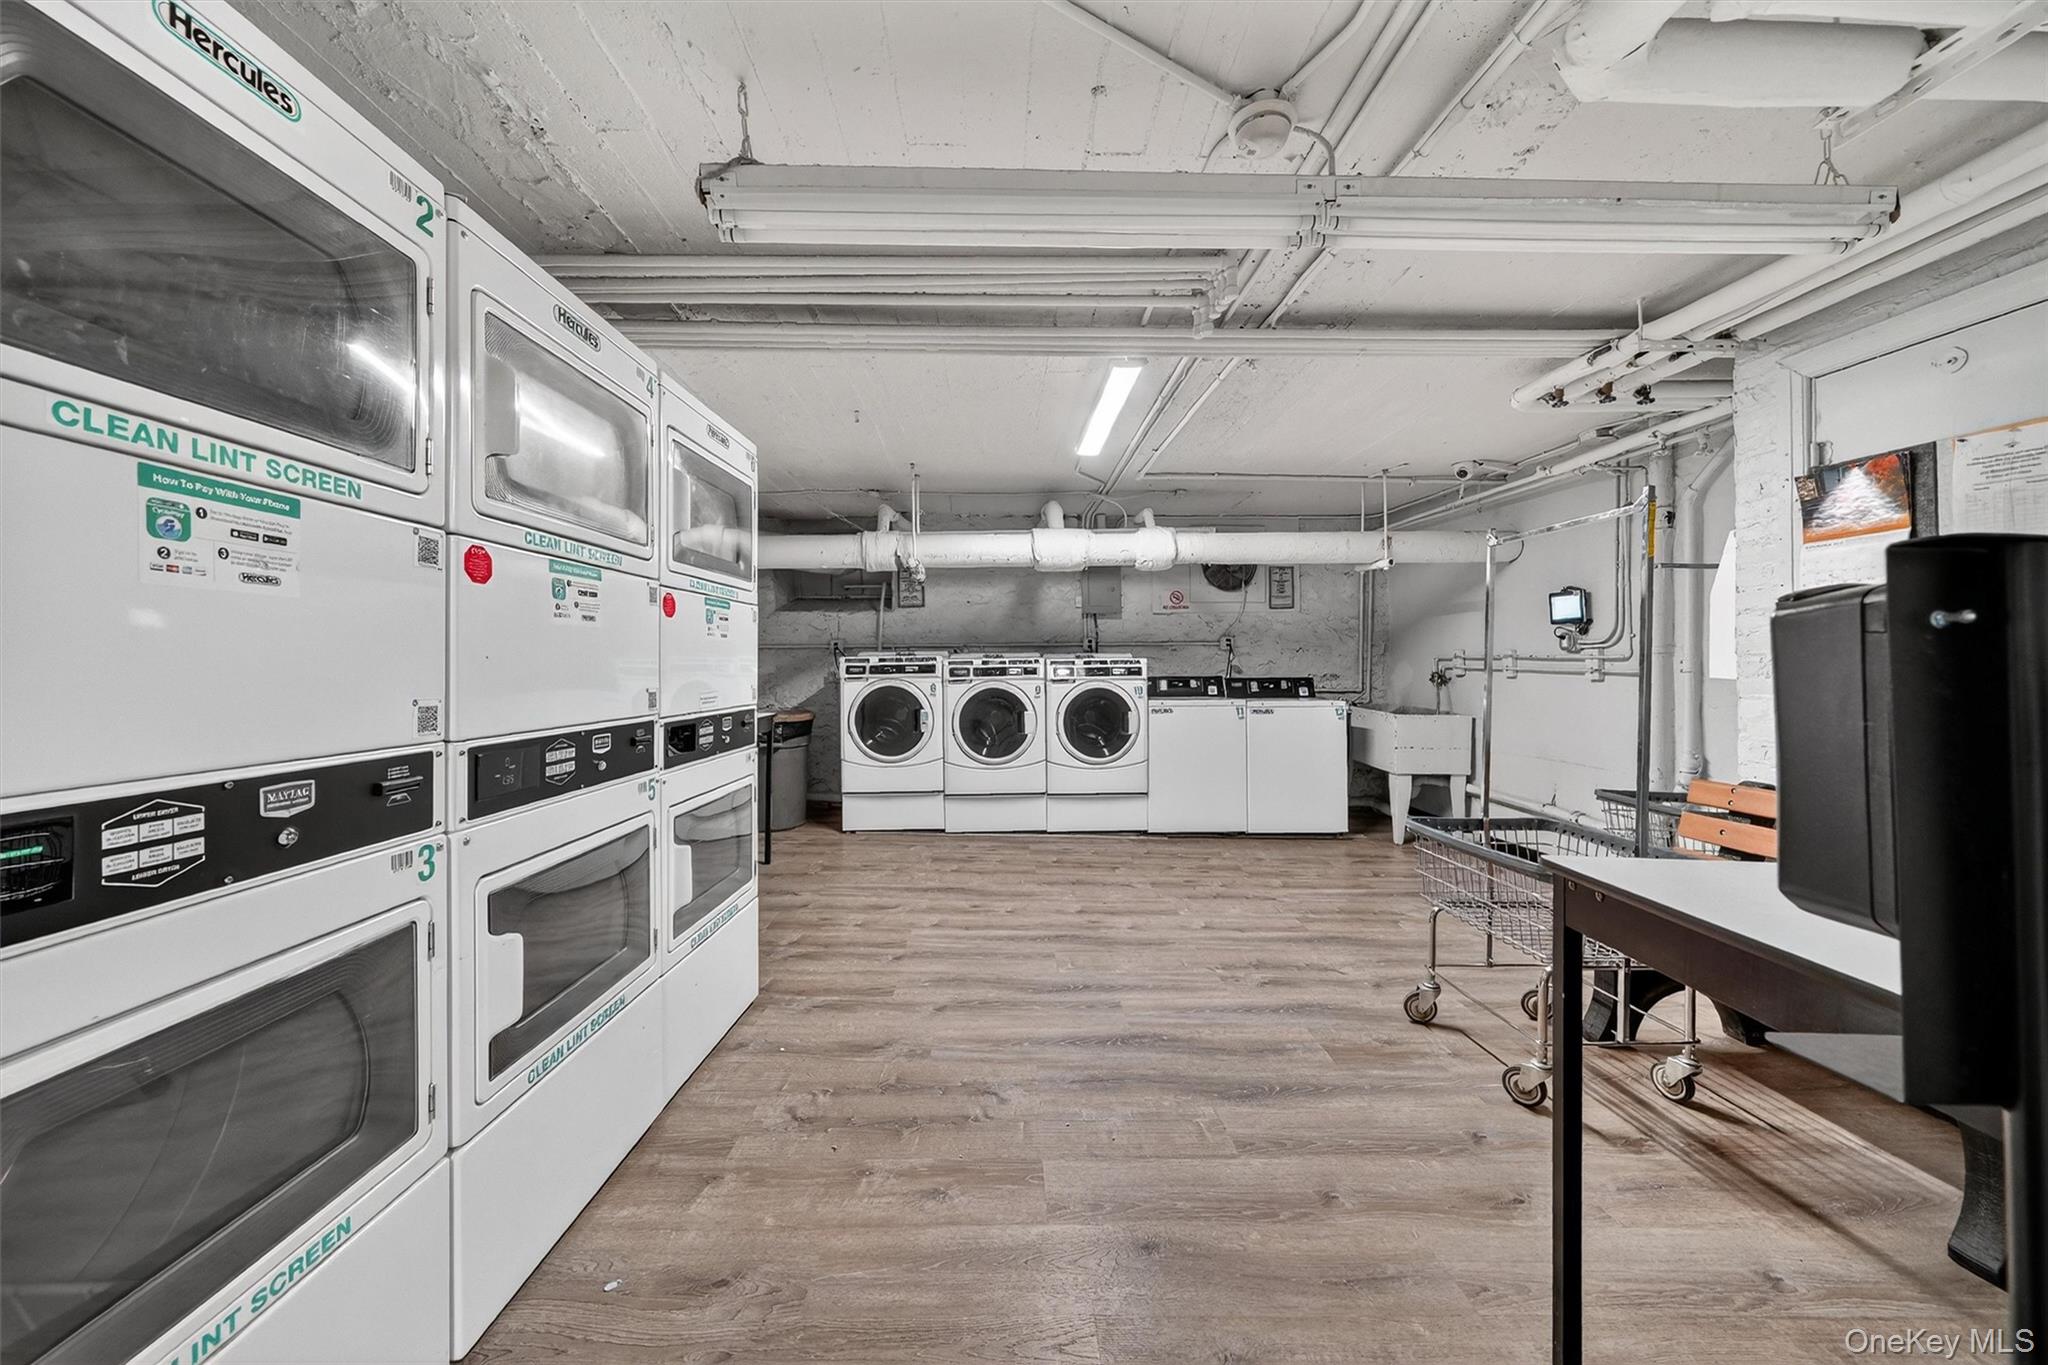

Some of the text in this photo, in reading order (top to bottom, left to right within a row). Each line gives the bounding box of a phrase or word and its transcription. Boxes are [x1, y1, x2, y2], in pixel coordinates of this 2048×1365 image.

[168, 2, 295, 116] Hercules
[415, 195, 434, 238] 2
[557, 306, 599, 349] Hercules
[646, 375, 654, 399] 4
[51, 400, 362, 500] CLEAN LINT SCREEN
[152, 473, 291, 512] How To Pay With Your Phone
[524, 531, 623, 566] CLEAN LINT SCREEN
[267, 787, 310, 803] MAYTAG
[648, 777, 656, 801] 5
[417, 844, 436, 882] 3
[527, 994, 626, 1085] CLEAN LINT SCREEN
[250, 1216, 352, 1314] SCREEN
